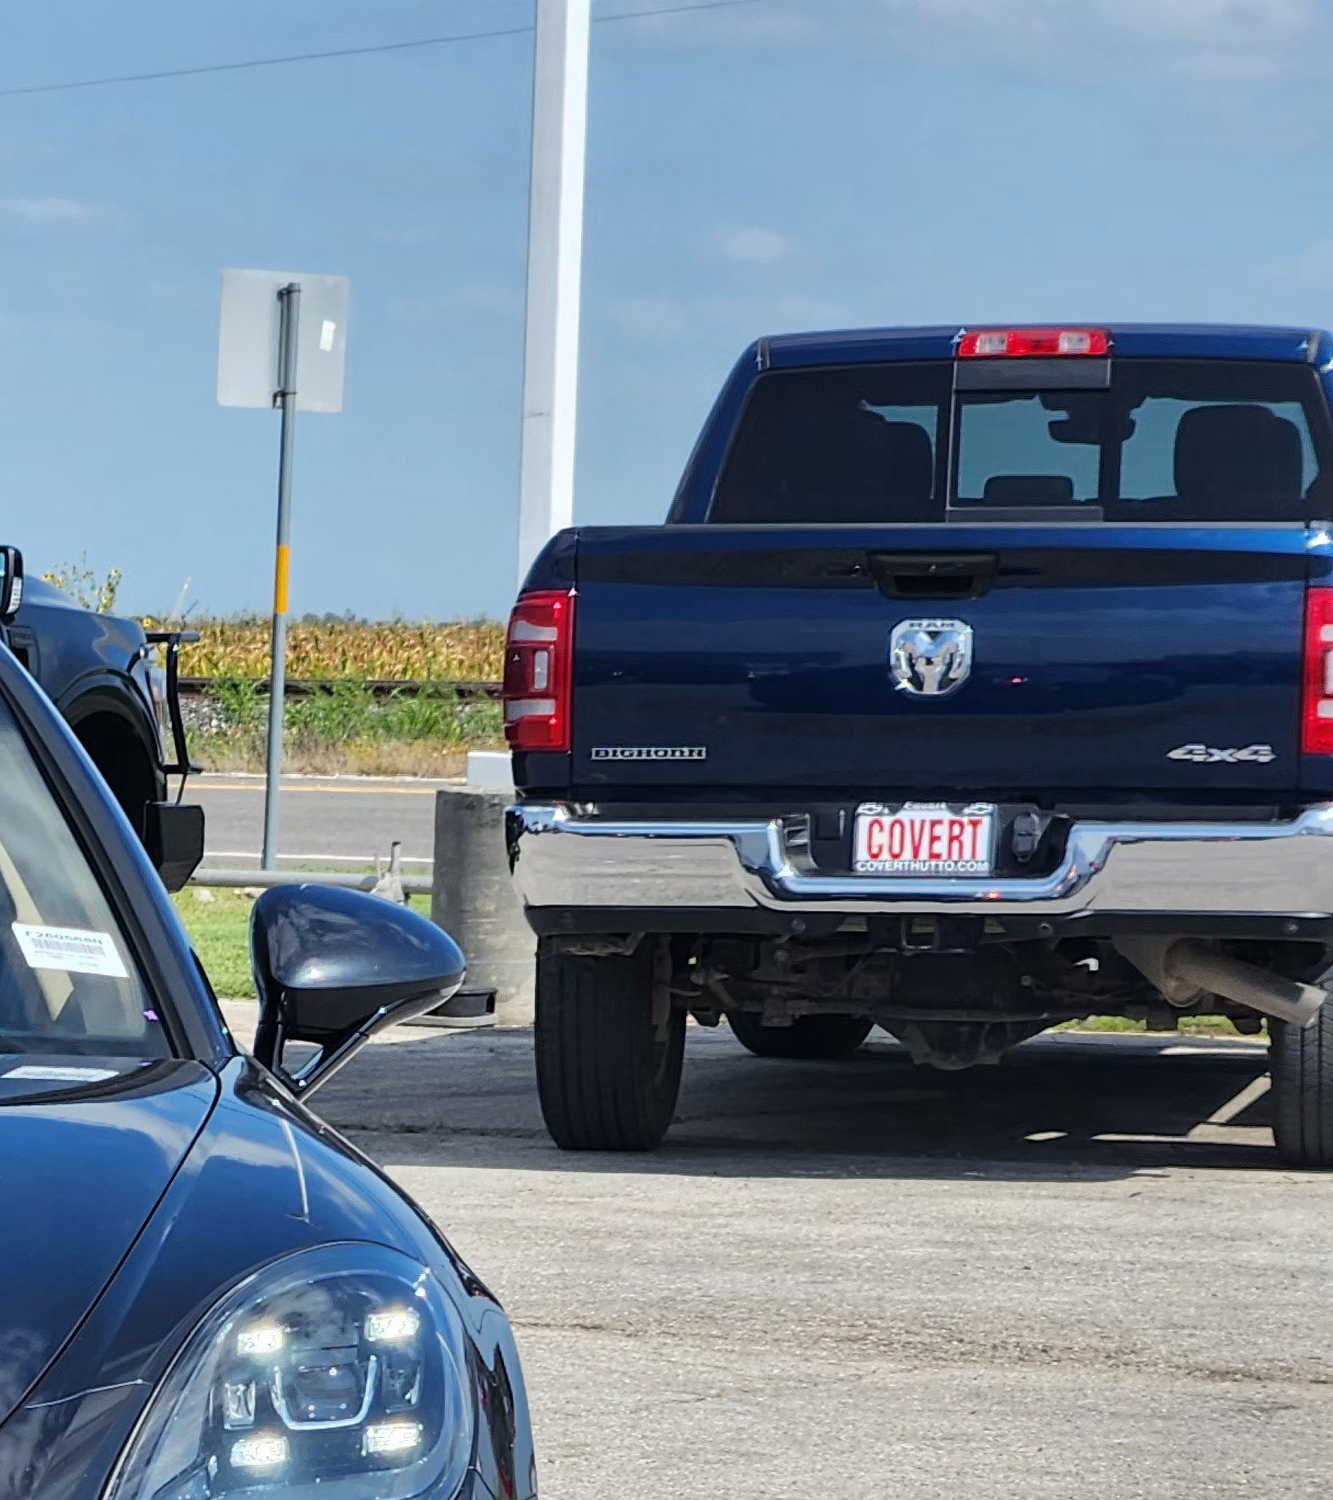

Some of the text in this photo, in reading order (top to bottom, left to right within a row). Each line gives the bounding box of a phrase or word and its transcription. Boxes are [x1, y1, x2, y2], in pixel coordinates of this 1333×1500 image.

[1166, 743, 1277, 763] 4x4
[866, 818, 983, 861] COVERT
[854, 861, 991, 872] COVERTHUTTO.COM
